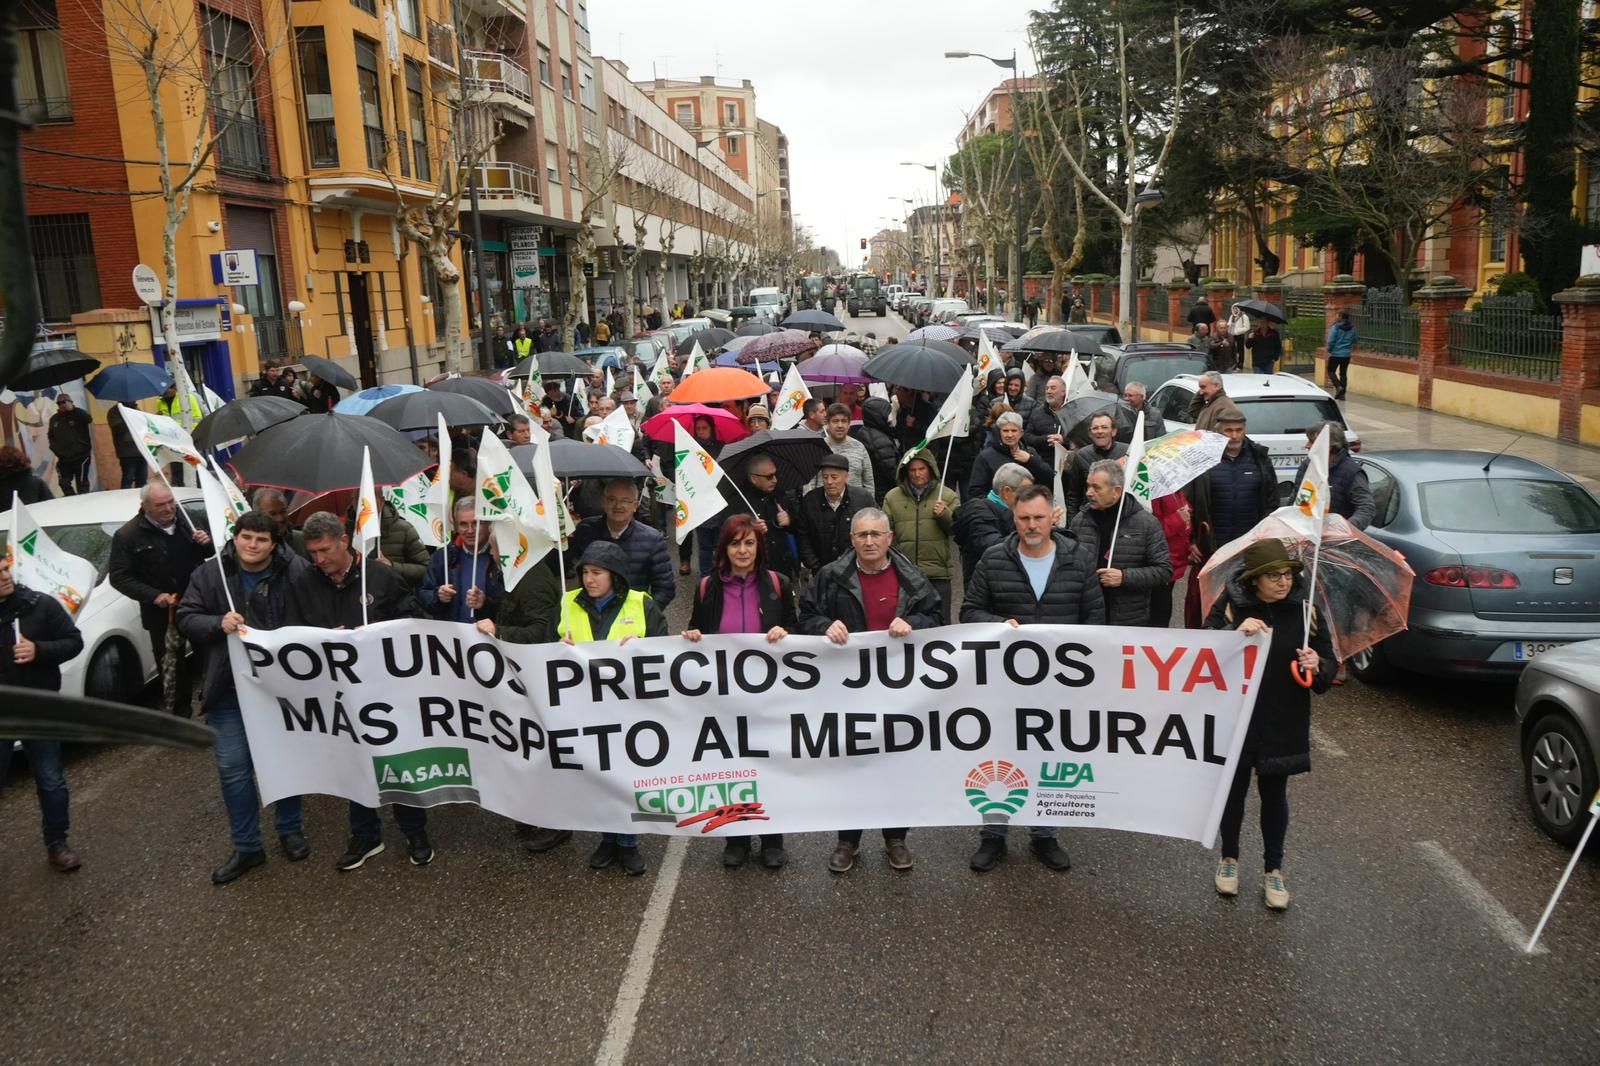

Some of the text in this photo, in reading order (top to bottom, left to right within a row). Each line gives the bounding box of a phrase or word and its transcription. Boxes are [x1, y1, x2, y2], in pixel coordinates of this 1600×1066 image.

[677, 468, 697, 499] ASAJA
[242, 634, 1258, 706] POR UNOS PRECIOS JUSTOS ¡YA!
[276, 691, 1227, 771] MÁS RESPETO AL MEDIO RURAL
[400, 763, 470, 784] ASAJA
[634, 769, 758, 788] UNIÓN DE CAMPESINOS
[1039, 762, 1094, 788] UPA
[638, 781, 756, 814] COAG
[1037, 800, 1095, 808] Agricultores
[1065, 792, 1096, 801] Pequeños
[1045, 809, 1095, 817] Ganaderos
